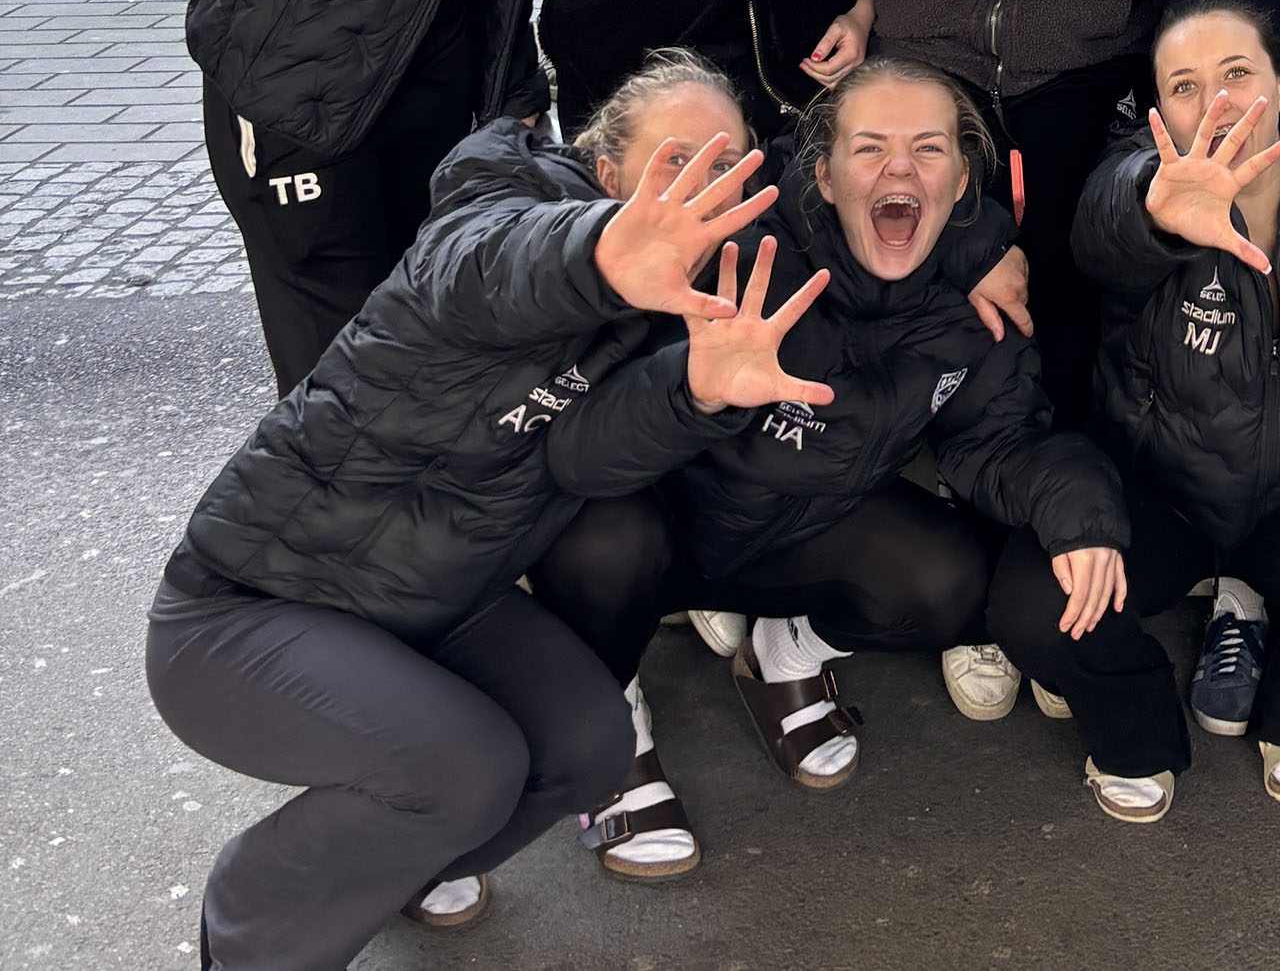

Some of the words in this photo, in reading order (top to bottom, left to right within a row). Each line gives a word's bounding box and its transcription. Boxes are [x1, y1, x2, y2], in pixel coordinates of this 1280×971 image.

[268, 172, 322, 206] TB
[1181, 300, 1236, 325] stadium
[1183, 321, 1222, 356] MJ
[554, 376, 590, 393] SELECT
[528, 387, 573, 412] stad
[762, 414, 803, 451] HA
